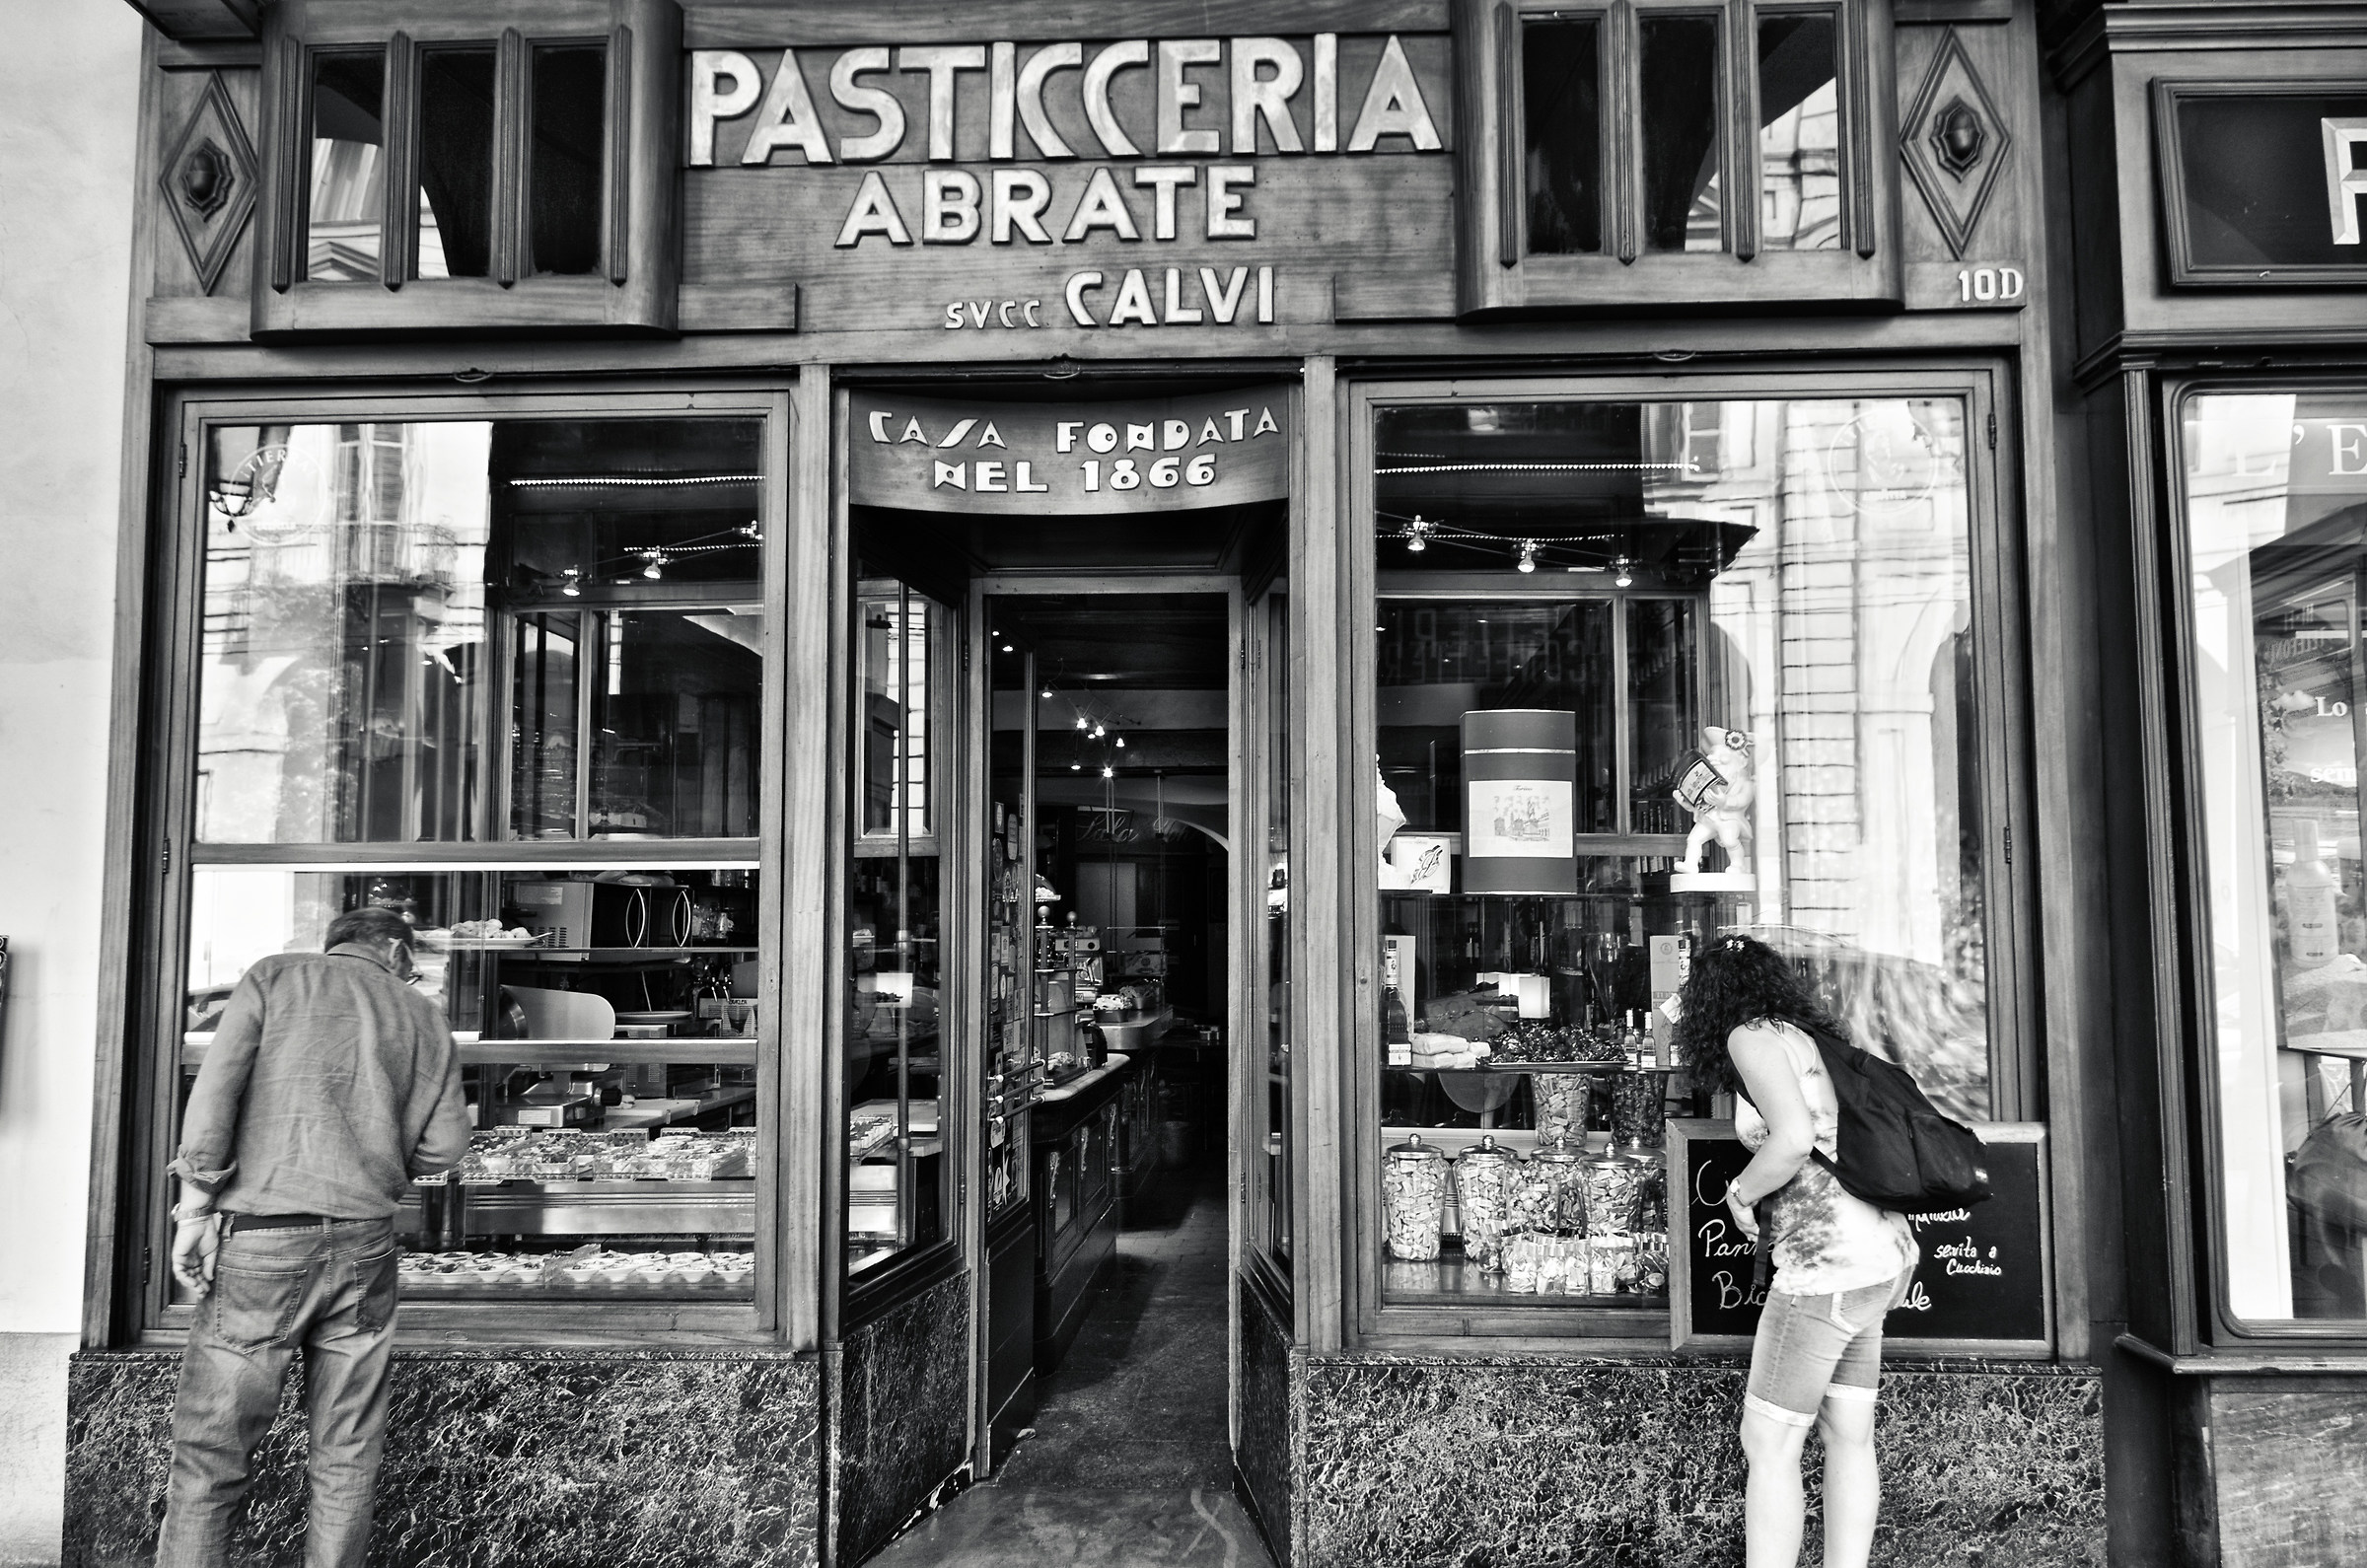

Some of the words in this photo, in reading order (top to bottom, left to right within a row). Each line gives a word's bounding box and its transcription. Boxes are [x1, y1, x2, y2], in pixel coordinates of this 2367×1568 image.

[690, 33, 1443, 168] PASTICCERIA
[834, 165, 1257, 249] ABRATE
[1065, 266, 1274, 326] CALVI
[1958, 267, 2024, 302] 10D
[868, 409, 1008, 450] CASA
[1056, 405, 1281, 455] FONDATA
[933, 461, 1048, 493] NEL
[1080, 454, 1218, 492] 1866
